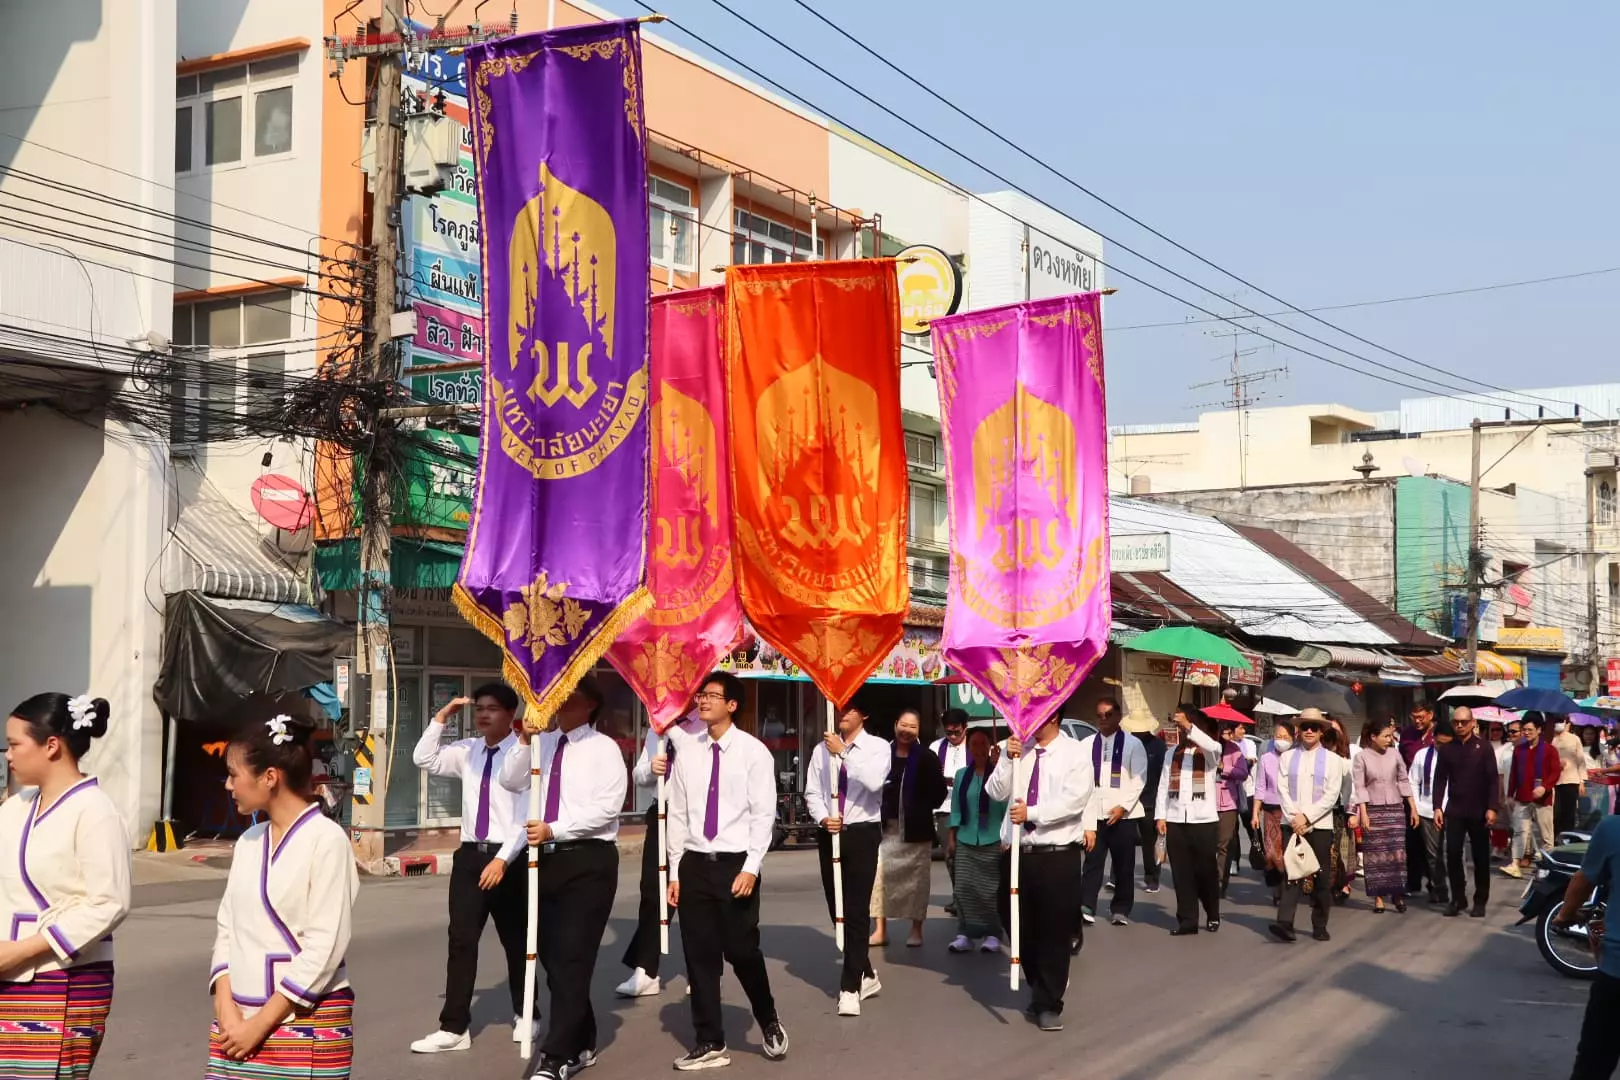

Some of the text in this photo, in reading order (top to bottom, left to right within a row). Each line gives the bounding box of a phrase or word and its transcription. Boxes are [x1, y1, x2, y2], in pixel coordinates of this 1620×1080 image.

[1033, 246, 1091, 292] ดวงหทัย
[554, 459, 579, 475] OF
